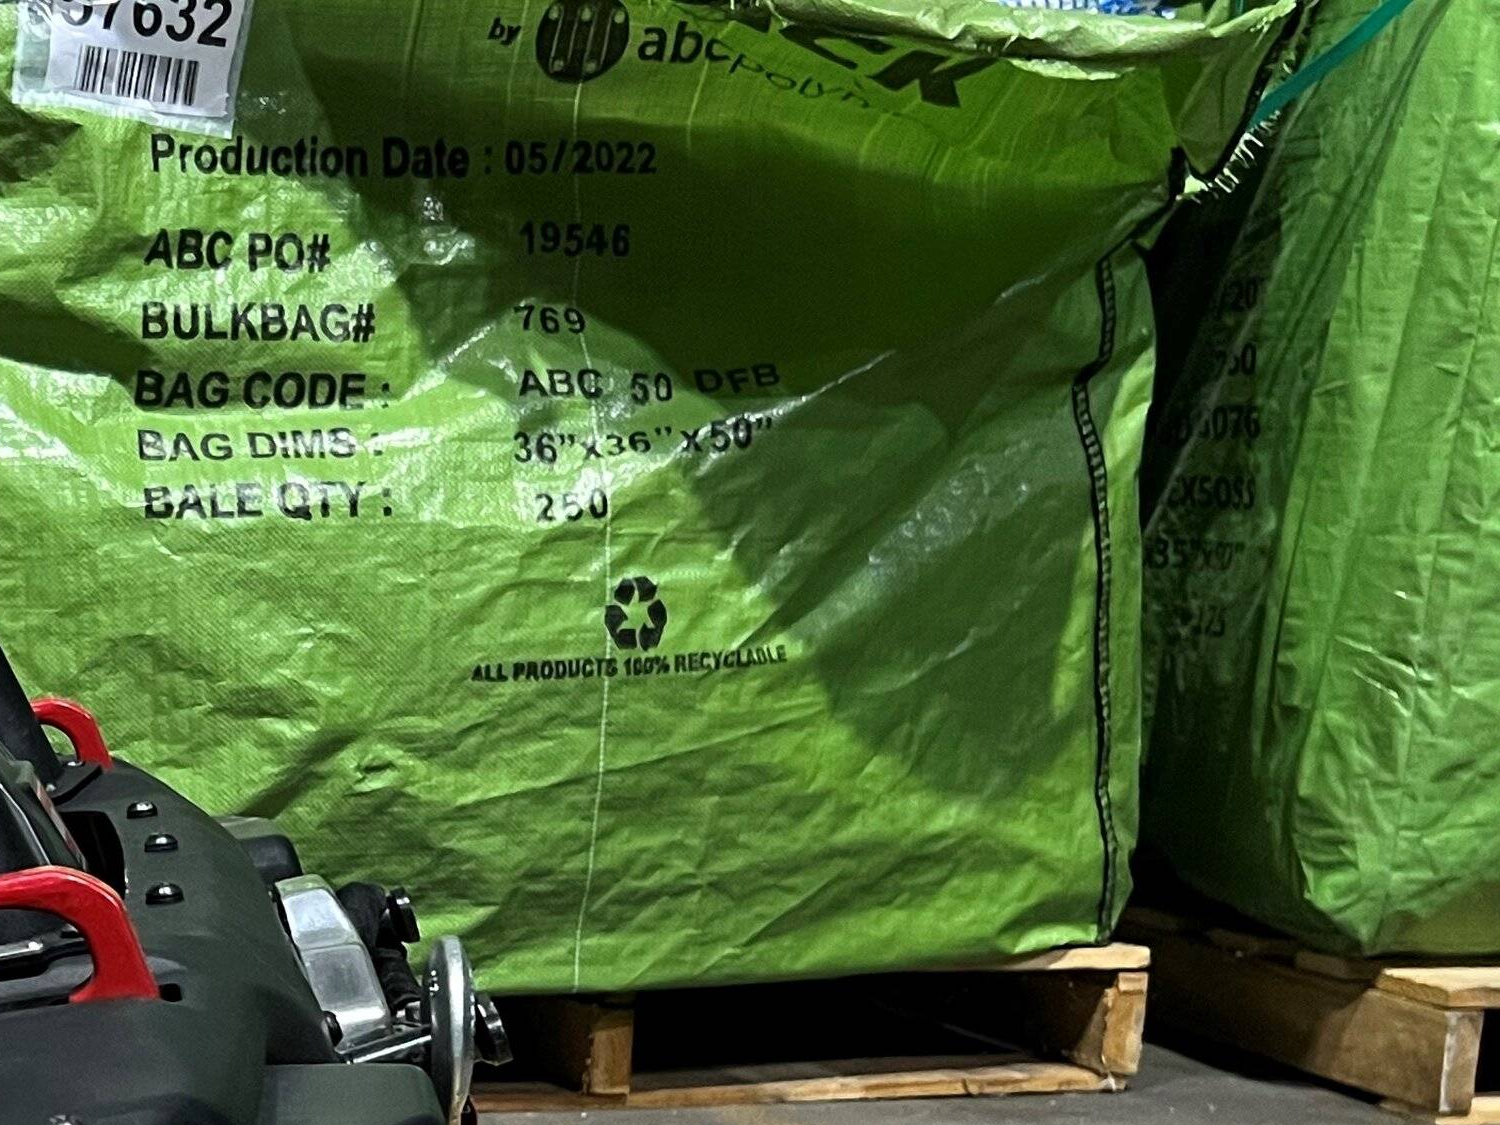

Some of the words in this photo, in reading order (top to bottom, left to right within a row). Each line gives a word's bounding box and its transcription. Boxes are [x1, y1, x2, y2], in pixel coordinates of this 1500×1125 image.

[488, 18, 521, 45] by
[151, 133, 369, 177] Production
[382, 136, 471, 178] Date
[504, 139, 658, 176] 05/2022
[144, 228, 233, 270] ABC
[248, 232, 331, 273] PO#
[518, 218, 631, 257] 19546
[141, 302, 376, 343] BULKBAG#
[513, 304, 585, 334] 769
[134, 369, 231, 409] BAG
[242, 370, 367, 411] CODE
[519, 368, 604, 399] ABC
[630, 371, 673, 404] 50
[692, 363, 780, 394] DFB
[137, 429, 234, 461] BAG
[247, 427, 356, 458] DIMS
[144, 484, 263, 519] BALE
[276, 481, 367, 520] QTY
[534, 488, 609, 522] 250
[471, 664, 508, 683] ALL
[512, 657, 618, 682] PRODUCTS
[622, 655, 670, 678] 100%
